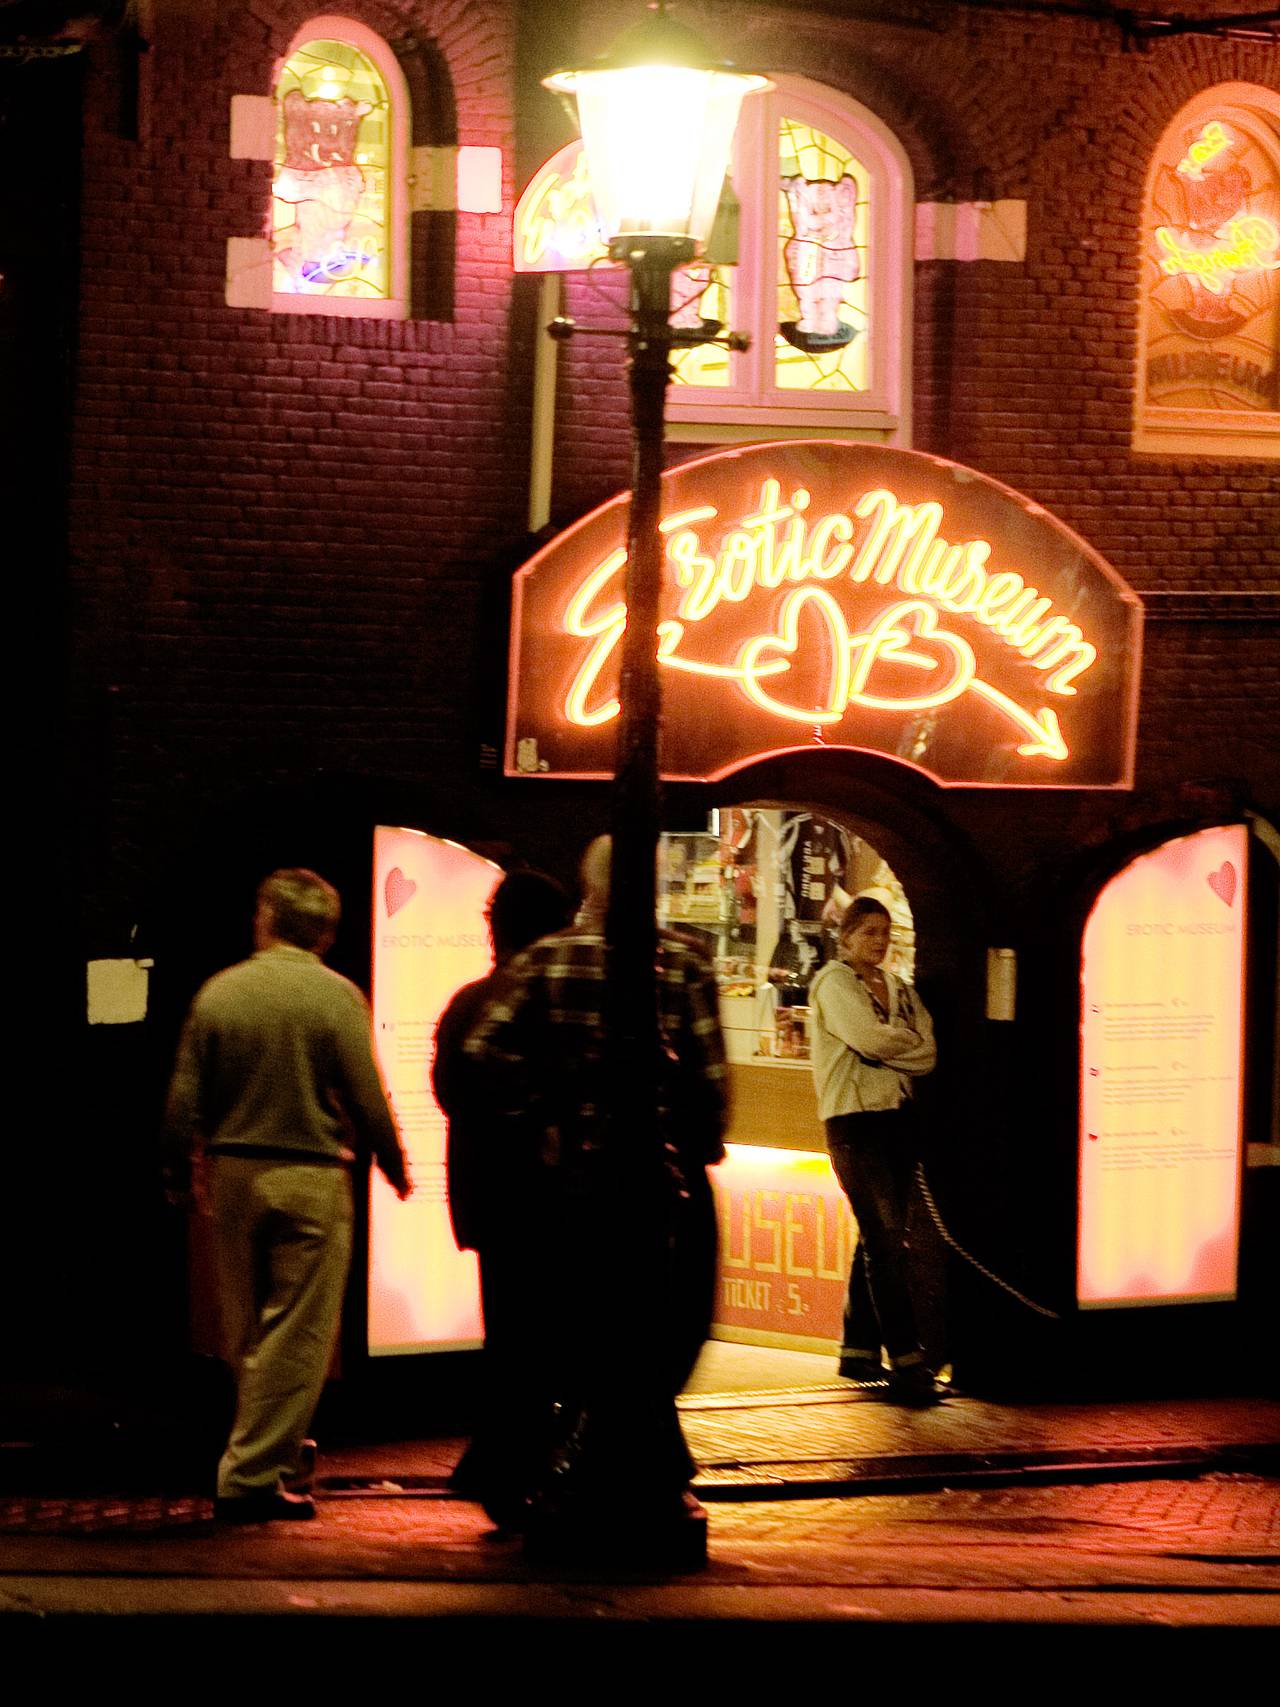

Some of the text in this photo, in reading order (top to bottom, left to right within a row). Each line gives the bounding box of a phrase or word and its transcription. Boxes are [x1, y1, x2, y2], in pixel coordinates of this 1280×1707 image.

[566, 477, 1099, 726] Erotic Museum
[383, 933, 491, 949] EROTIC MUSEU
[1126, 922, 1175, 937] EROTIC
[721, 1276, 772, 1312] TICKET
